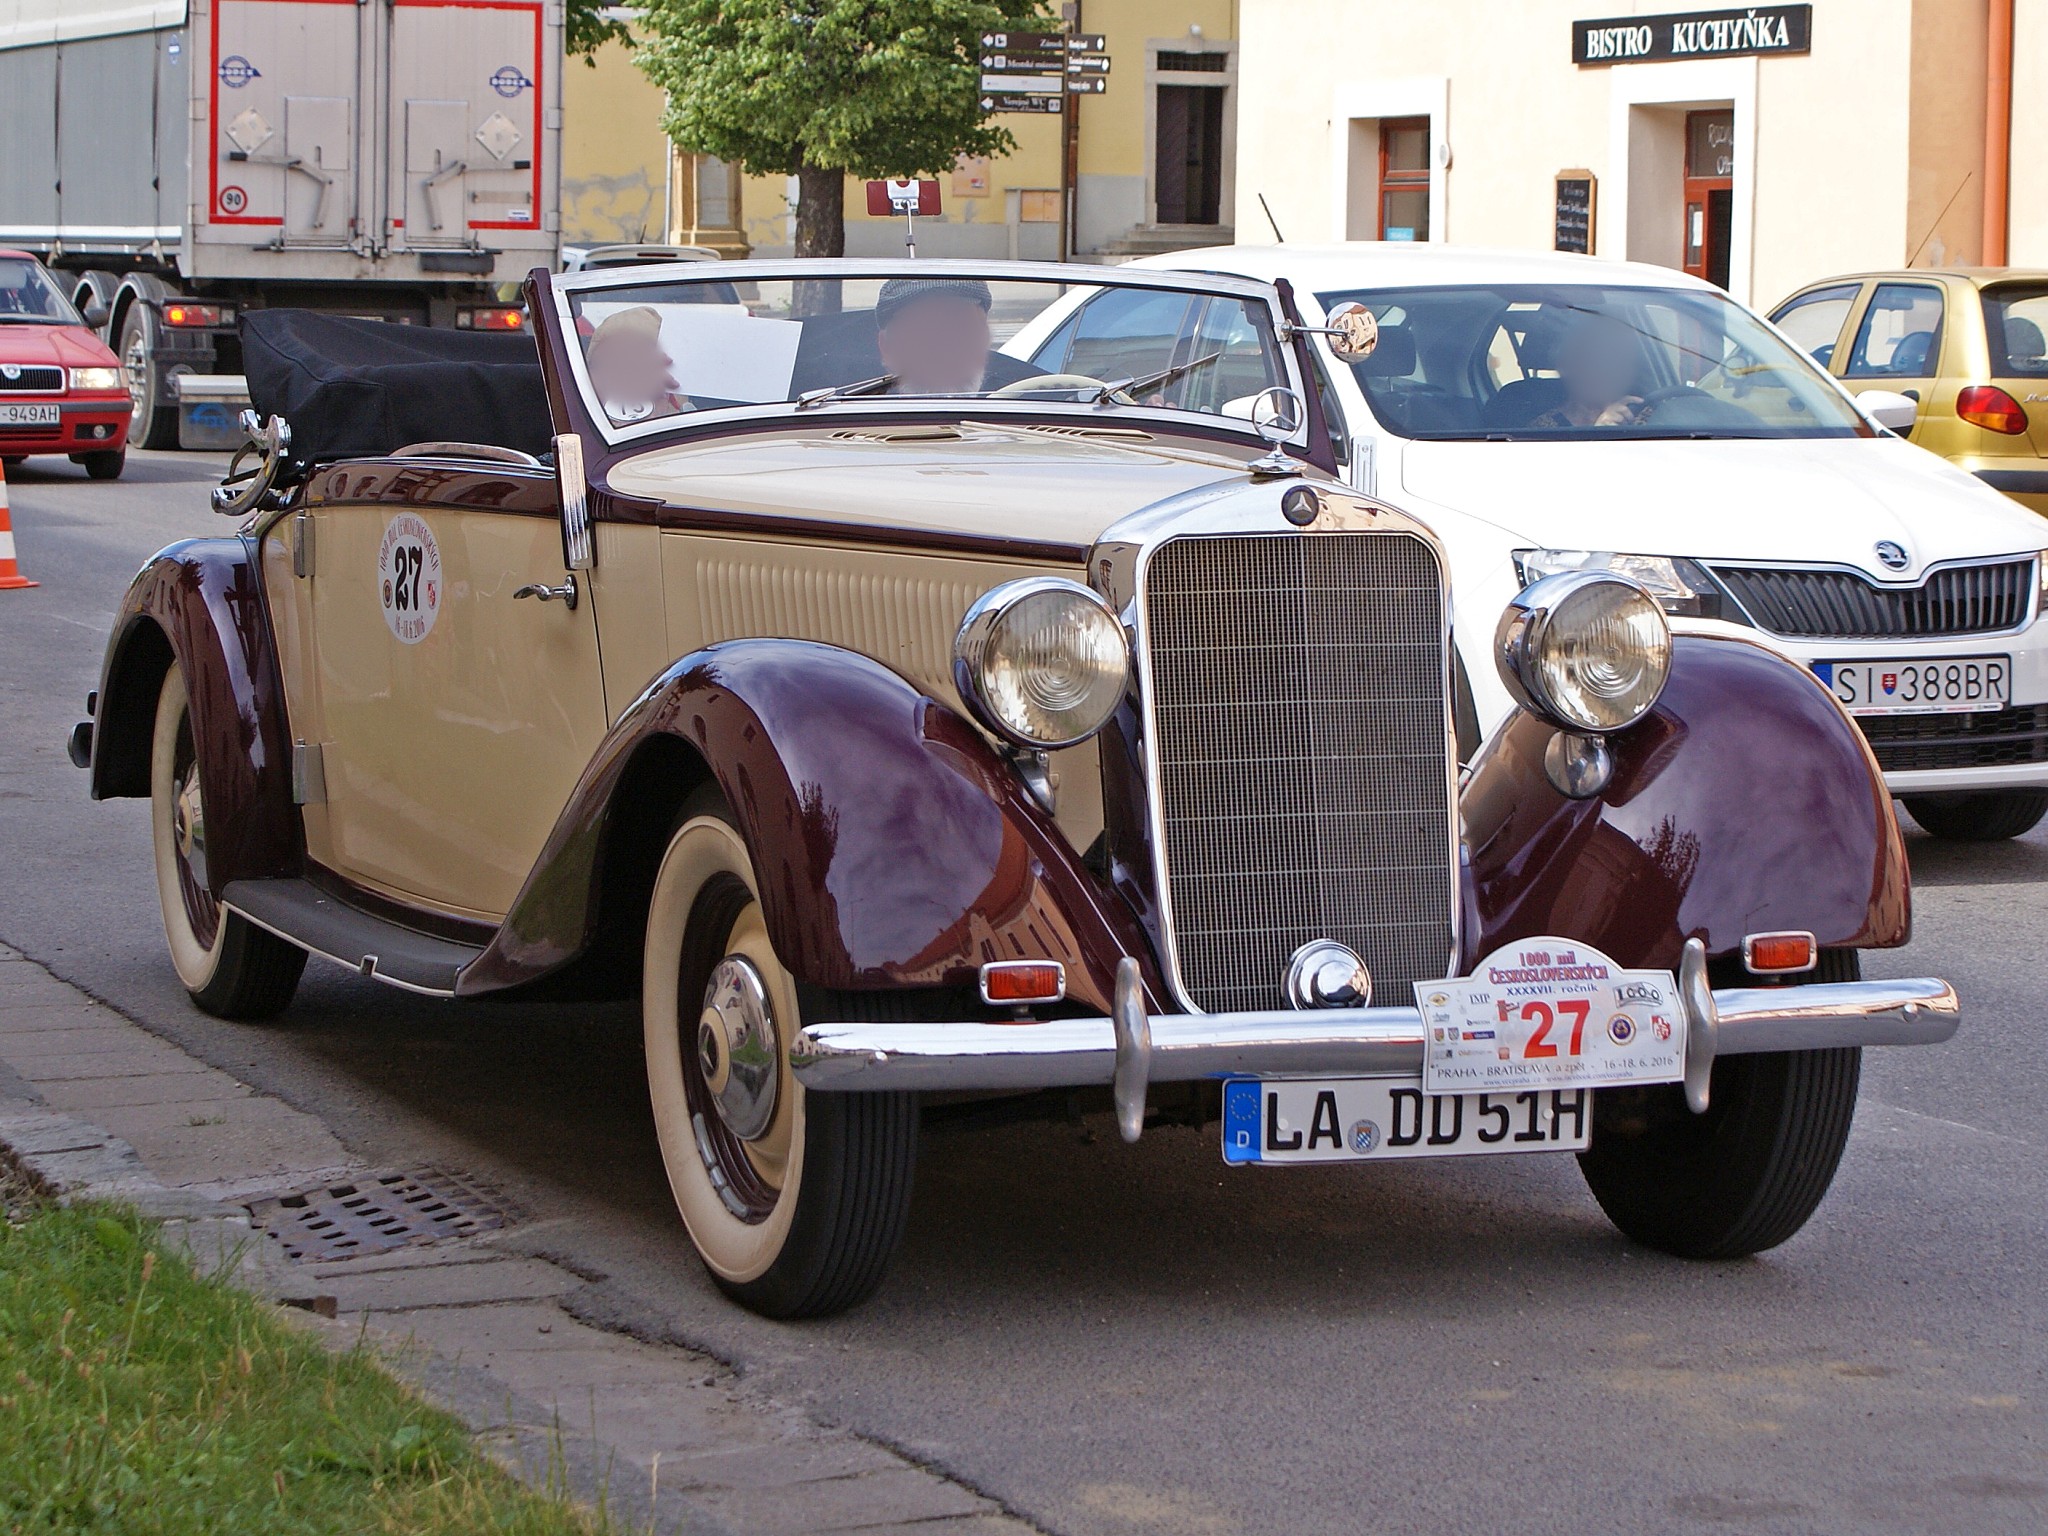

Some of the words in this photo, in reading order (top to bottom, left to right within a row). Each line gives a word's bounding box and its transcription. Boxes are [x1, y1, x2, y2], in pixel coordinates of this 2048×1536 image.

[1586, 25, 1653, 59] BISTRO
[1671, 9, 1790, 53] KUCHYŇKA
[226, 192, 241, 206] 90
[394, 545, 423, 612] 27
[1901, 663, 2003, 702] 388BR
[1519, 952, 1551, 967] 1000
[1488, 962, 1609, 985] ČESKOSLOVENSKÝCH
[1561, 983, 1599, 994] ročník
[1520, 999, 1591, 1059] 27
[1437, 1068, 1478, 1078] PRAHA
[1486, 1063, 1551, 1077] BRATISLAVA
[1651, 1056, 1674, 1068] 2016
[1267, 1091, 1343, 1150] LA
[1387, 1088, 1463, 1146] DD
[1478, 1088, 1585, 1142] 51H
[1237, 1130, 1250, 1148] D
